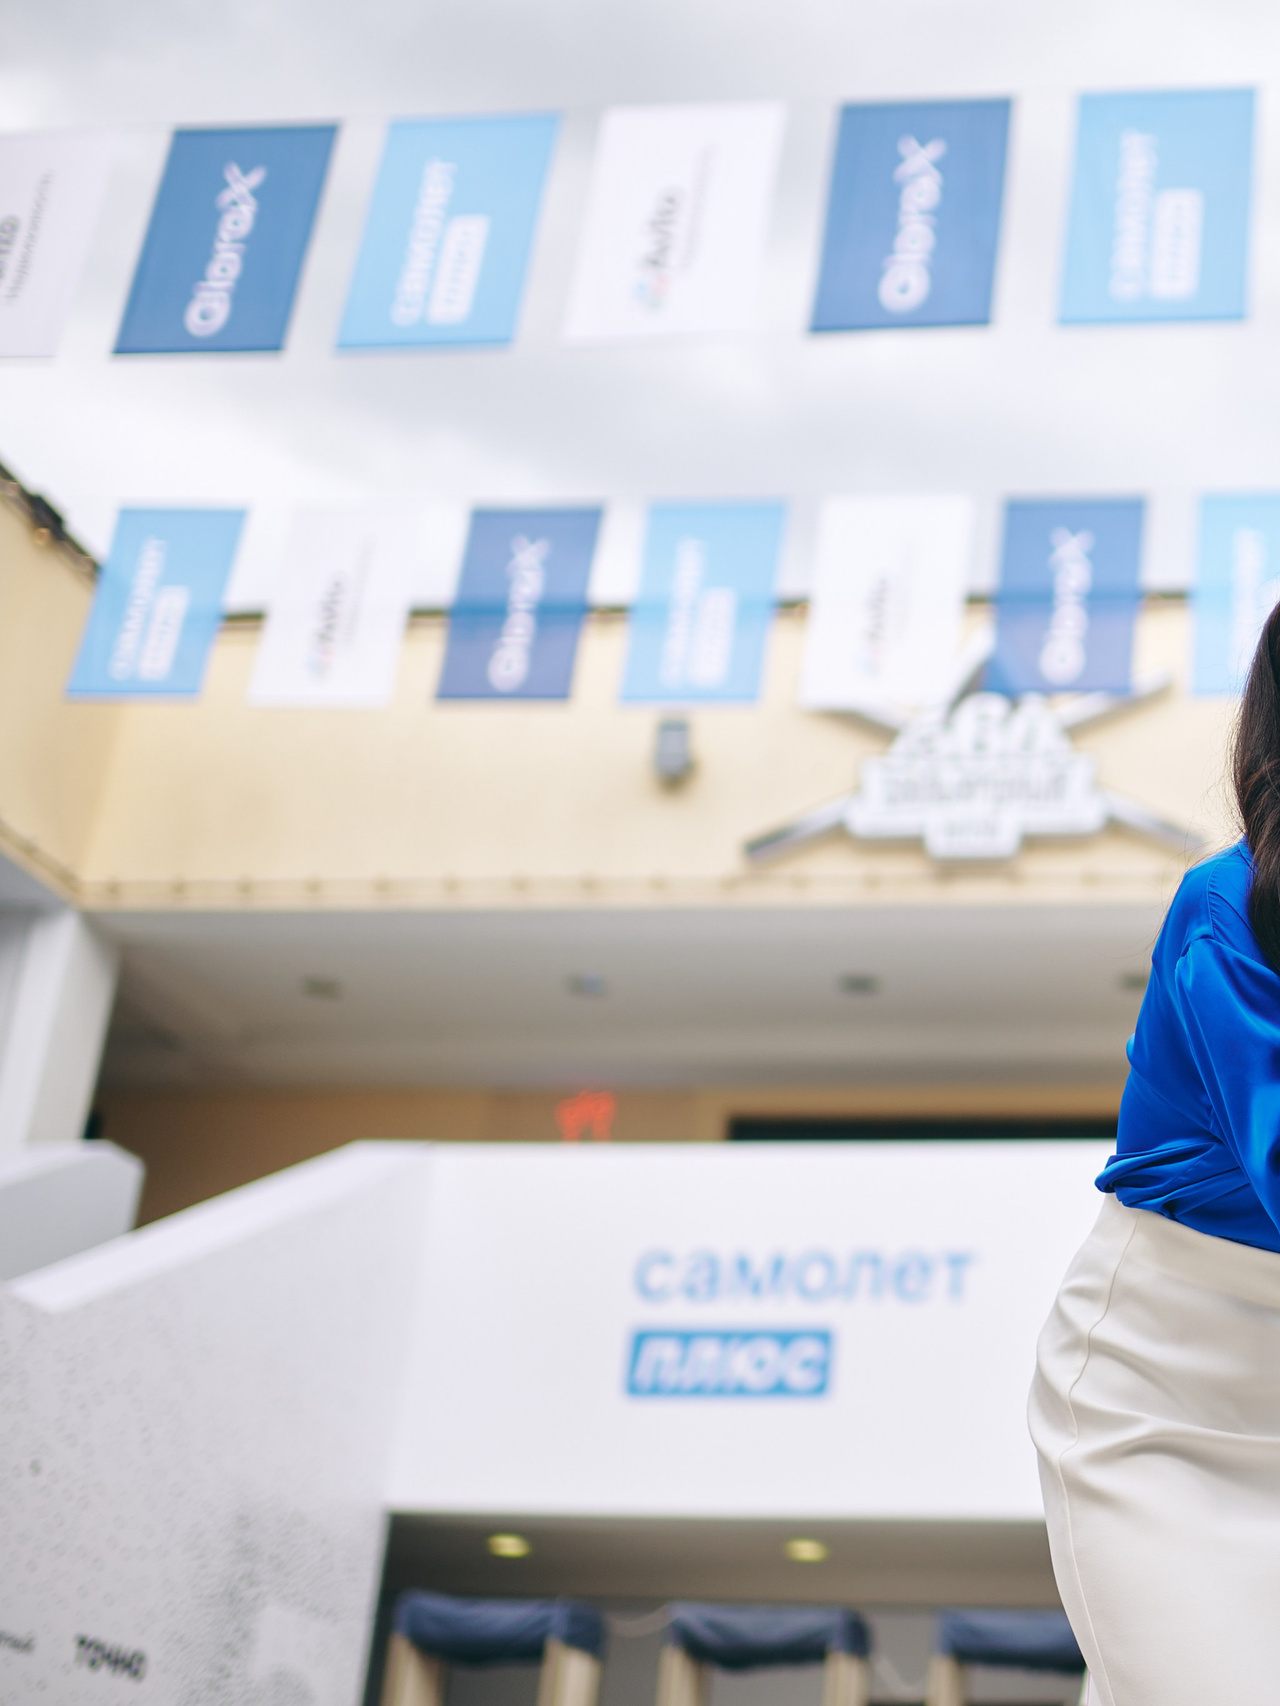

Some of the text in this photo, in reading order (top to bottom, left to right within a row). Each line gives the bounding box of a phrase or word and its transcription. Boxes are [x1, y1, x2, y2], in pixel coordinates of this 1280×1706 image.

[184, 161, 267, 338] GloraX
[878, 132, 948, 314] GloraX
[633, 1247, 974, 1305] самолет
